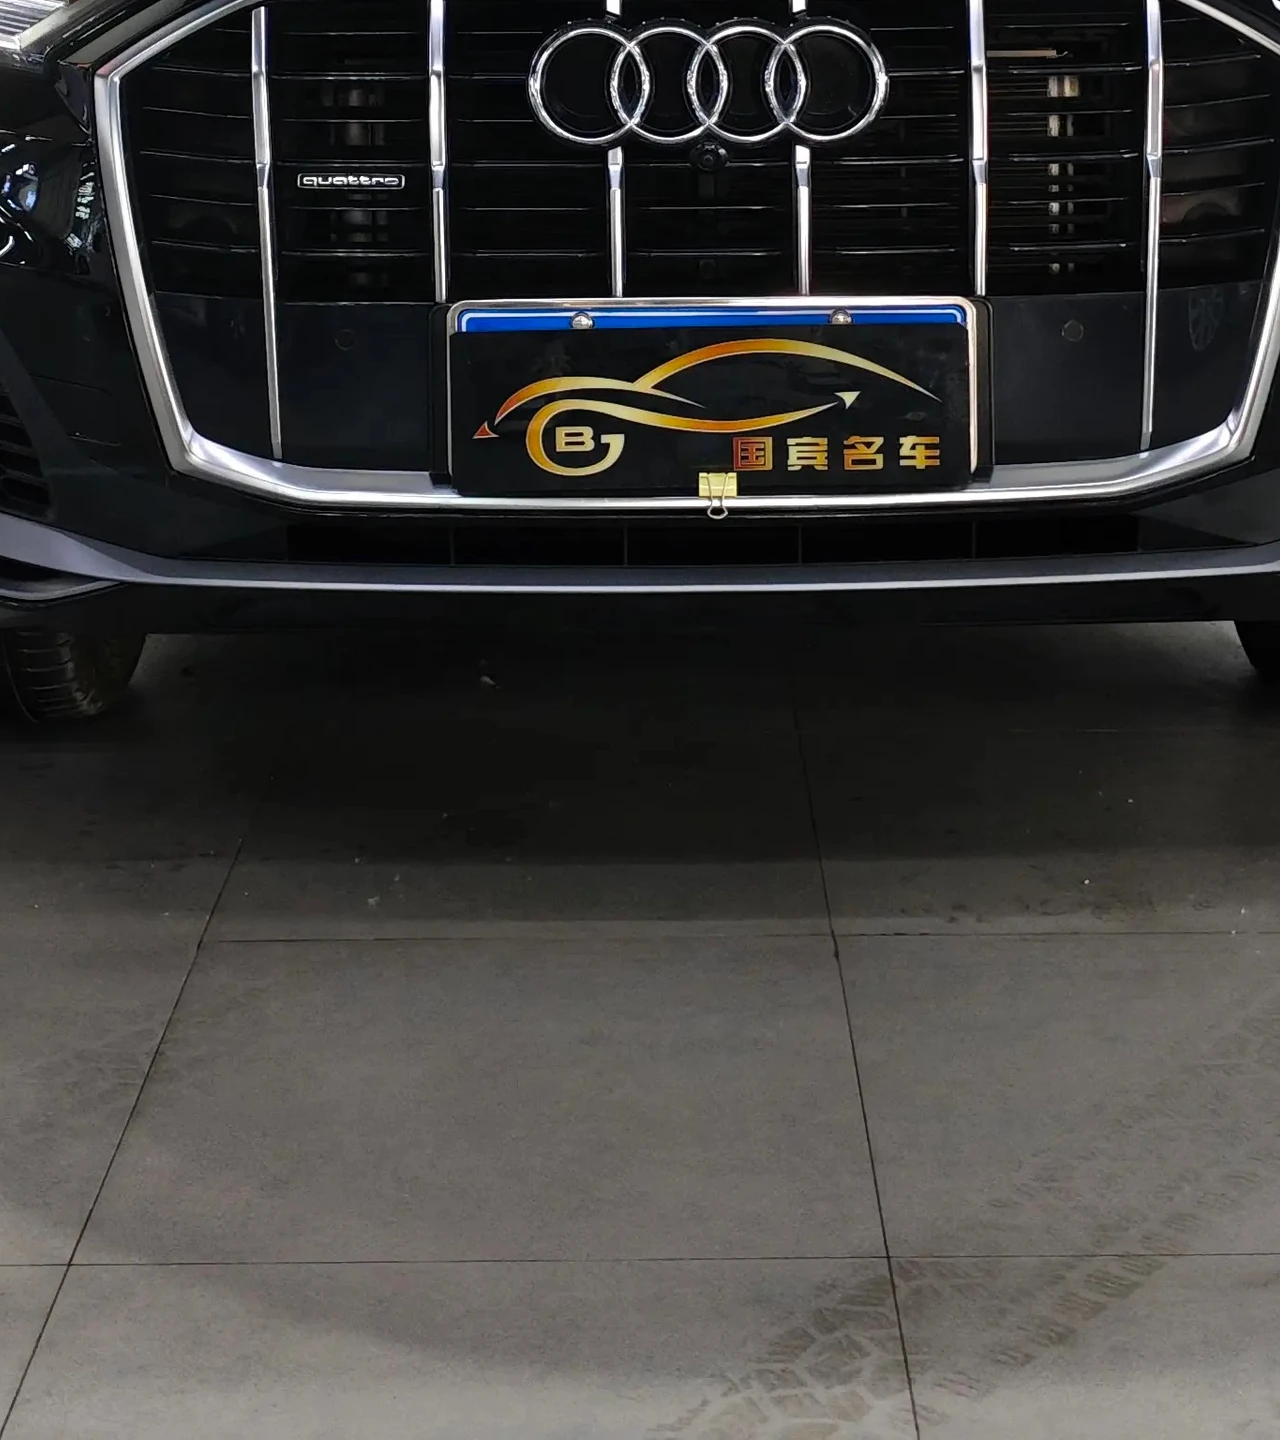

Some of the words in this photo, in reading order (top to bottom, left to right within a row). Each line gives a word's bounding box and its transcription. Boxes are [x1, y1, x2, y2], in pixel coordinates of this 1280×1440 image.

[303, 175, 399, 187] quattro
[732, 435, 940, 471] 国宾名车
